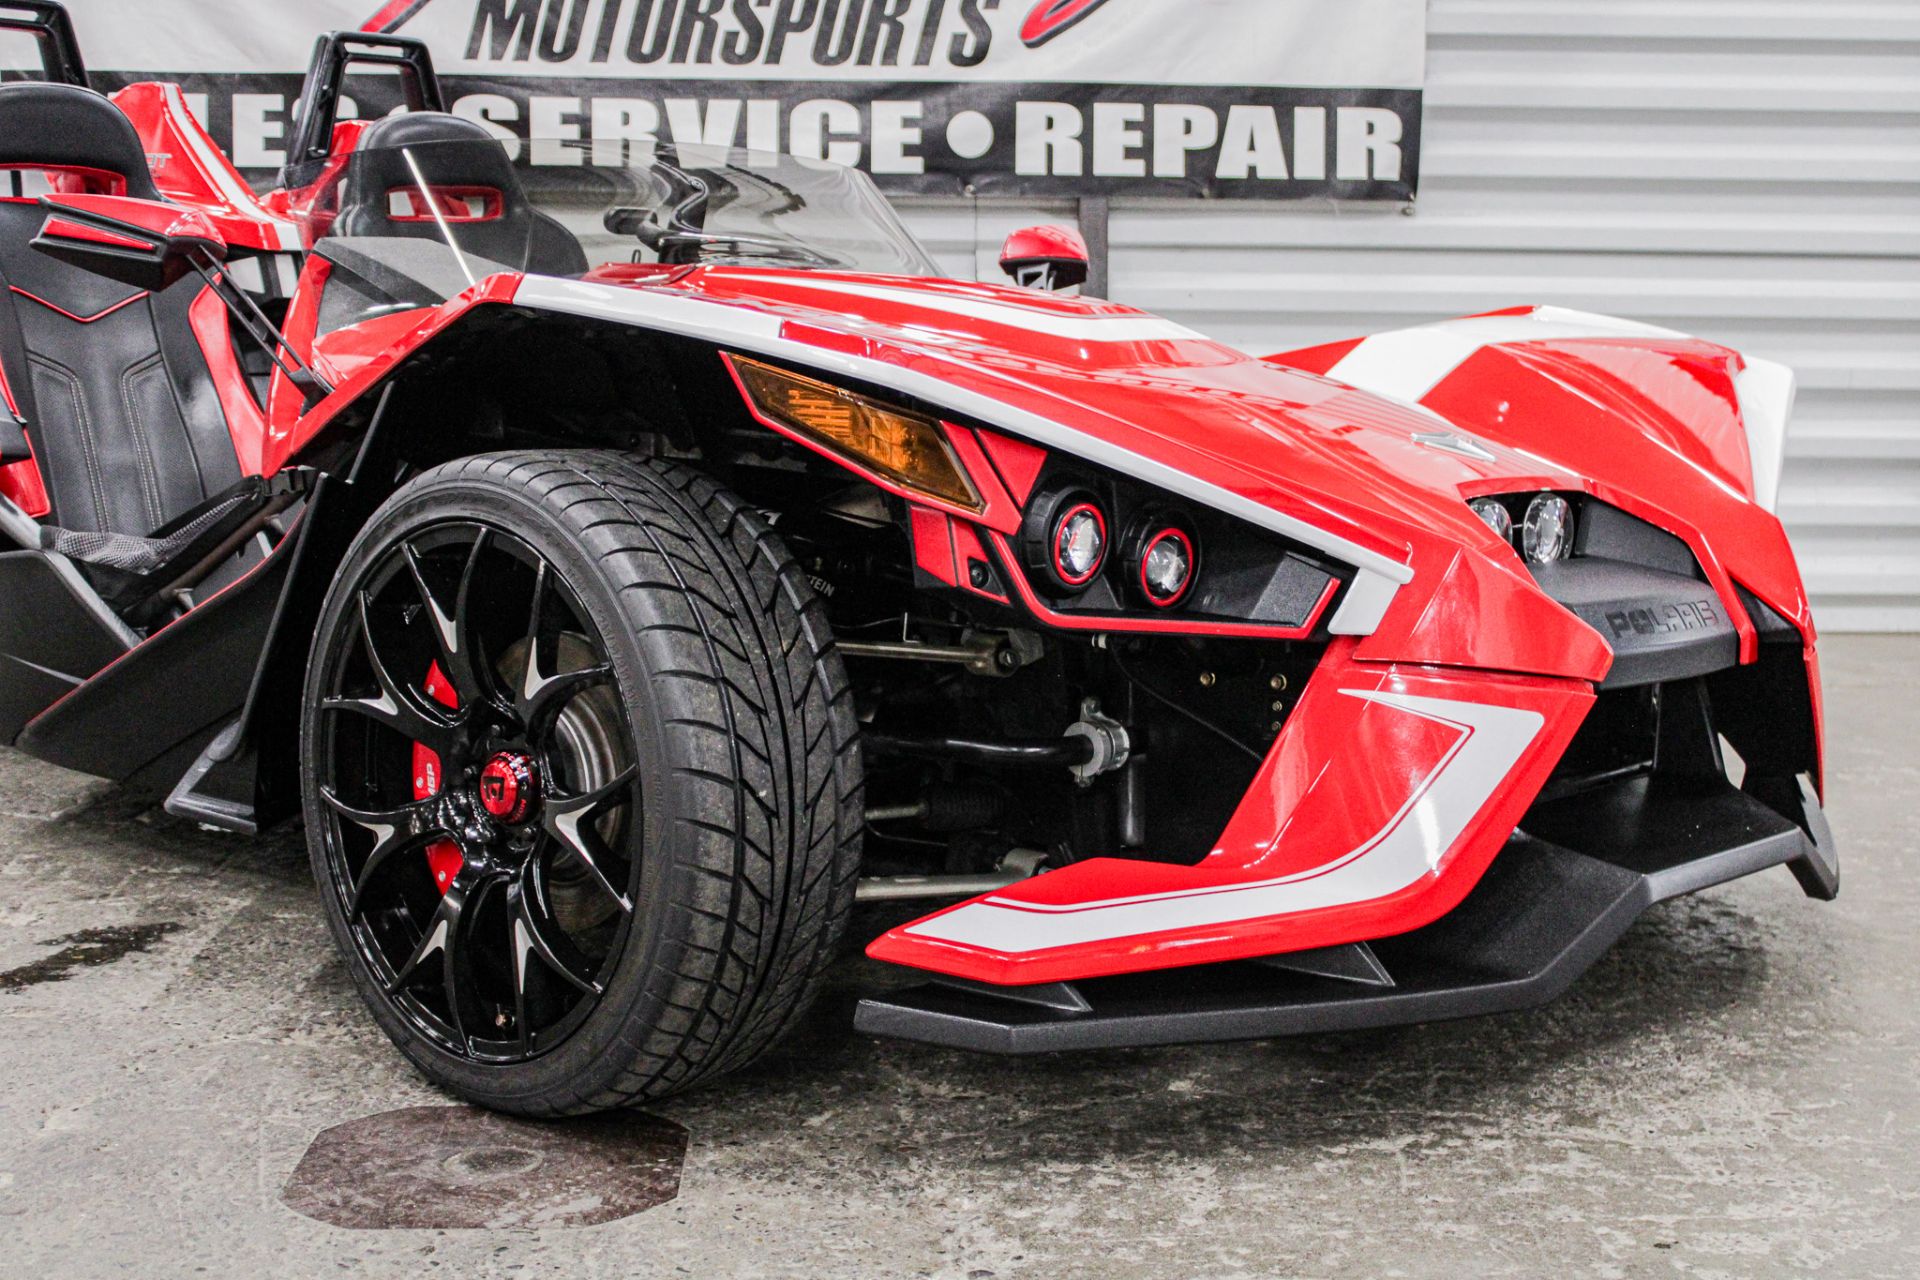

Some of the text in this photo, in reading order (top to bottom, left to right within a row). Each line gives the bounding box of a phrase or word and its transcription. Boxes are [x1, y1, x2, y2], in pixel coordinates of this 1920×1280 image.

[452, 94, 925, 175] SERVICE
[1015, 101, 1403, 181] REPAIR
[1604, 600, 1719, 638] POLARIS
